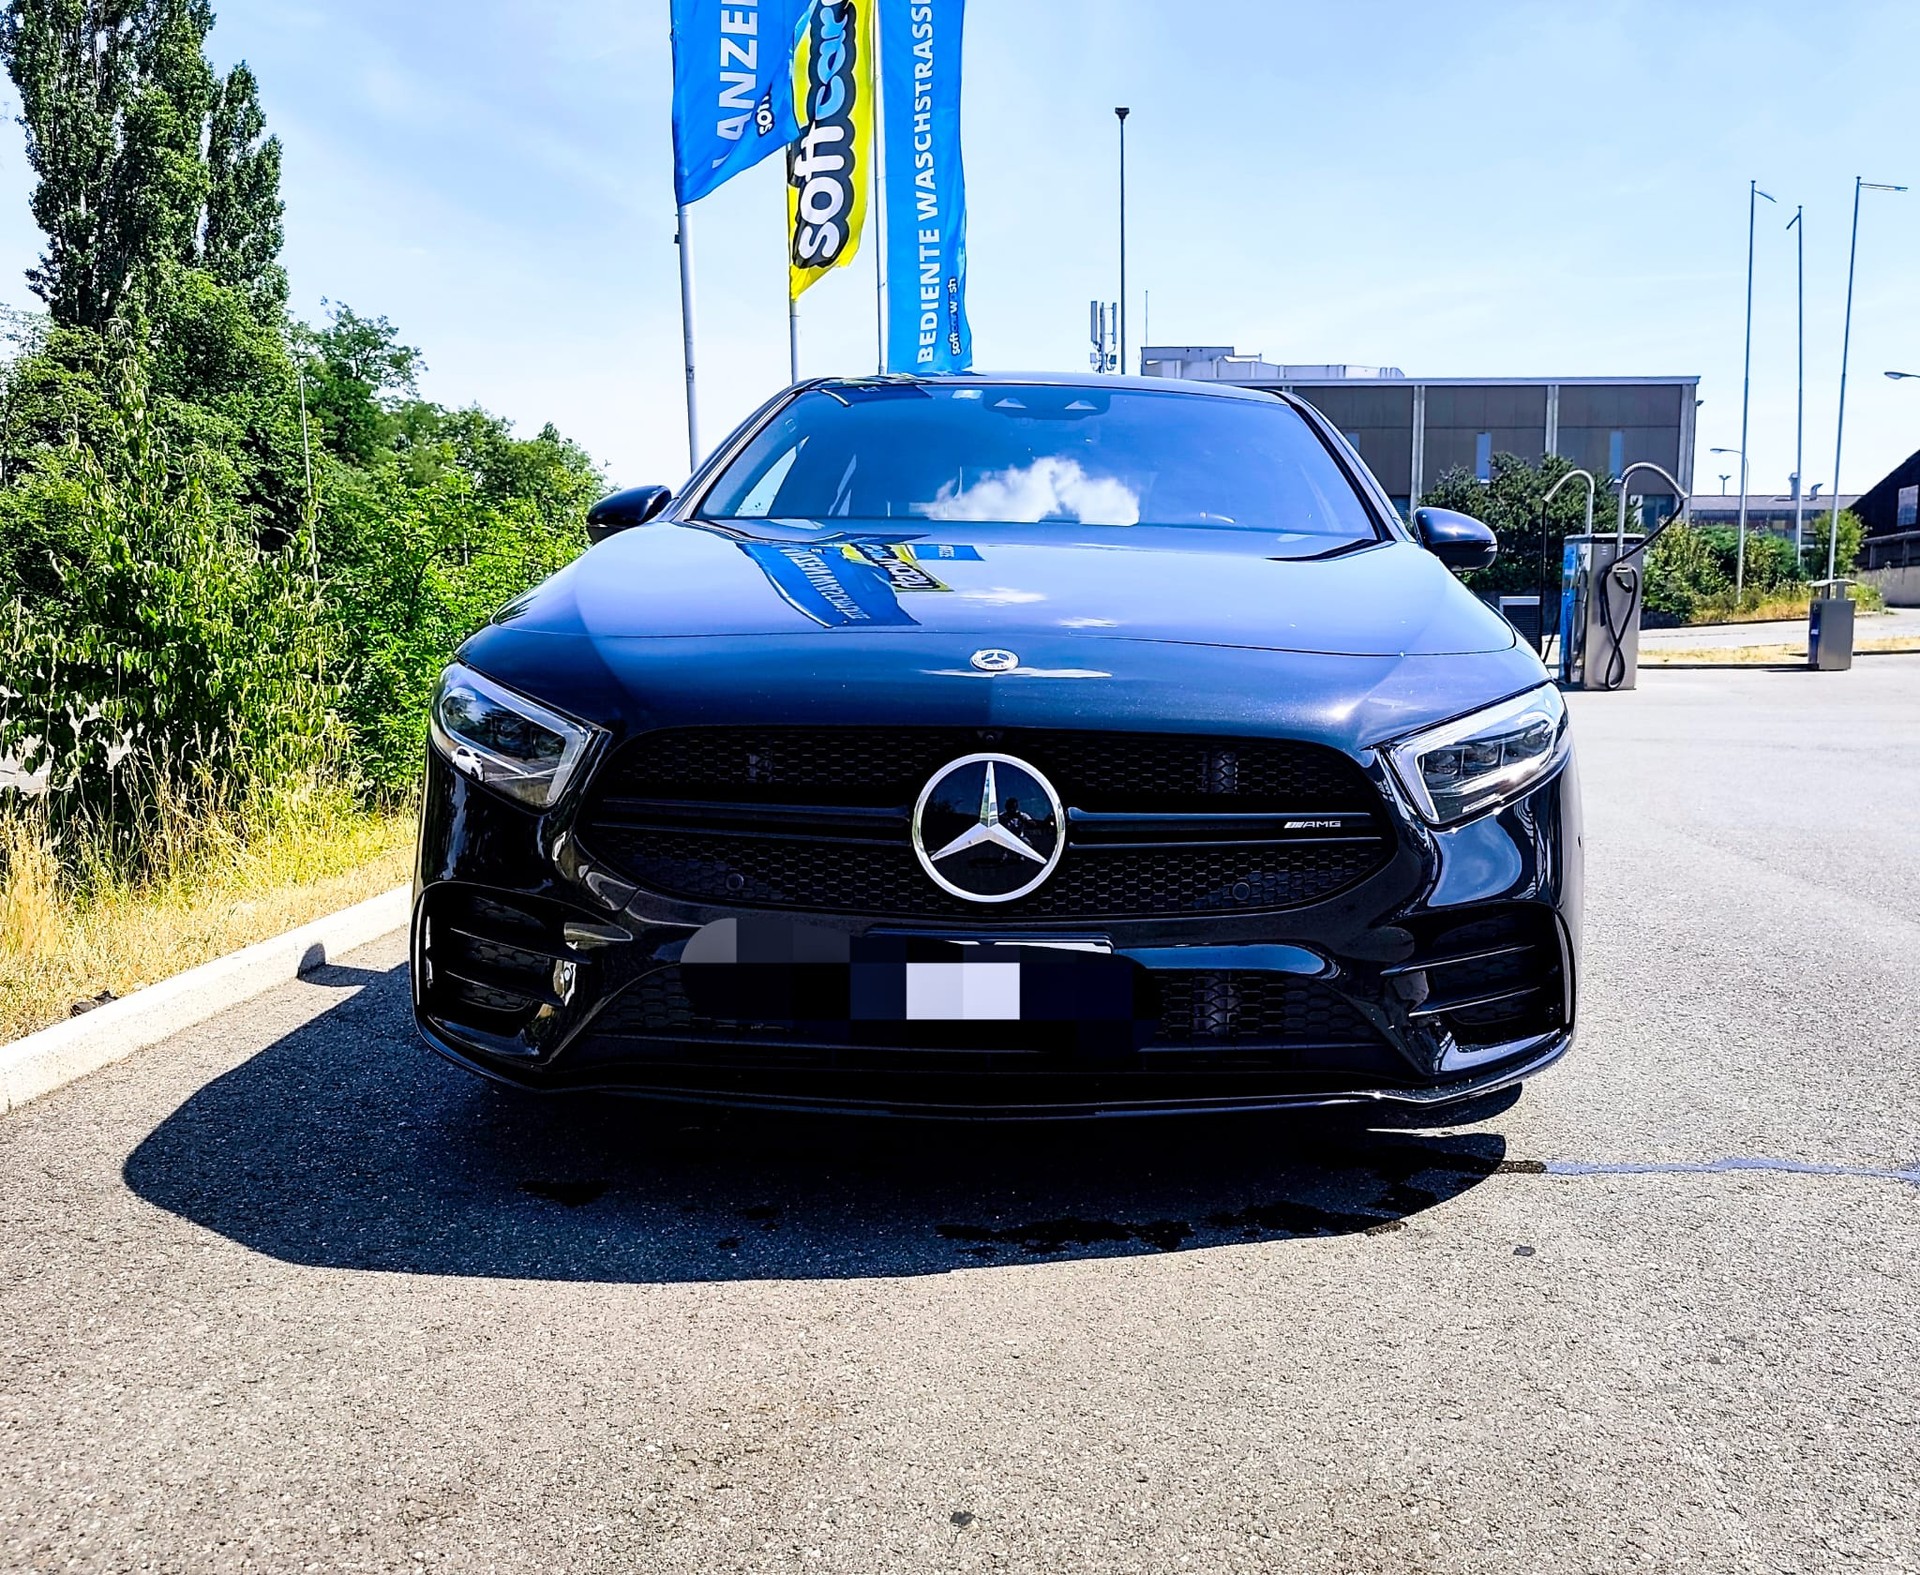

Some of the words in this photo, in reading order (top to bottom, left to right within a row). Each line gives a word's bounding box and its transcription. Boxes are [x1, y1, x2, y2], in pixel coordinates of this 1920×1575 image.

[712, 0, 758, 169] ANZE
[794, 0, 849, 259] softcar
[910, 0, 939, 222] WASCHSTRASS
[916, 229, 940, 364] BEDIENTE
[1301, 820, 1342, 829] AMG
